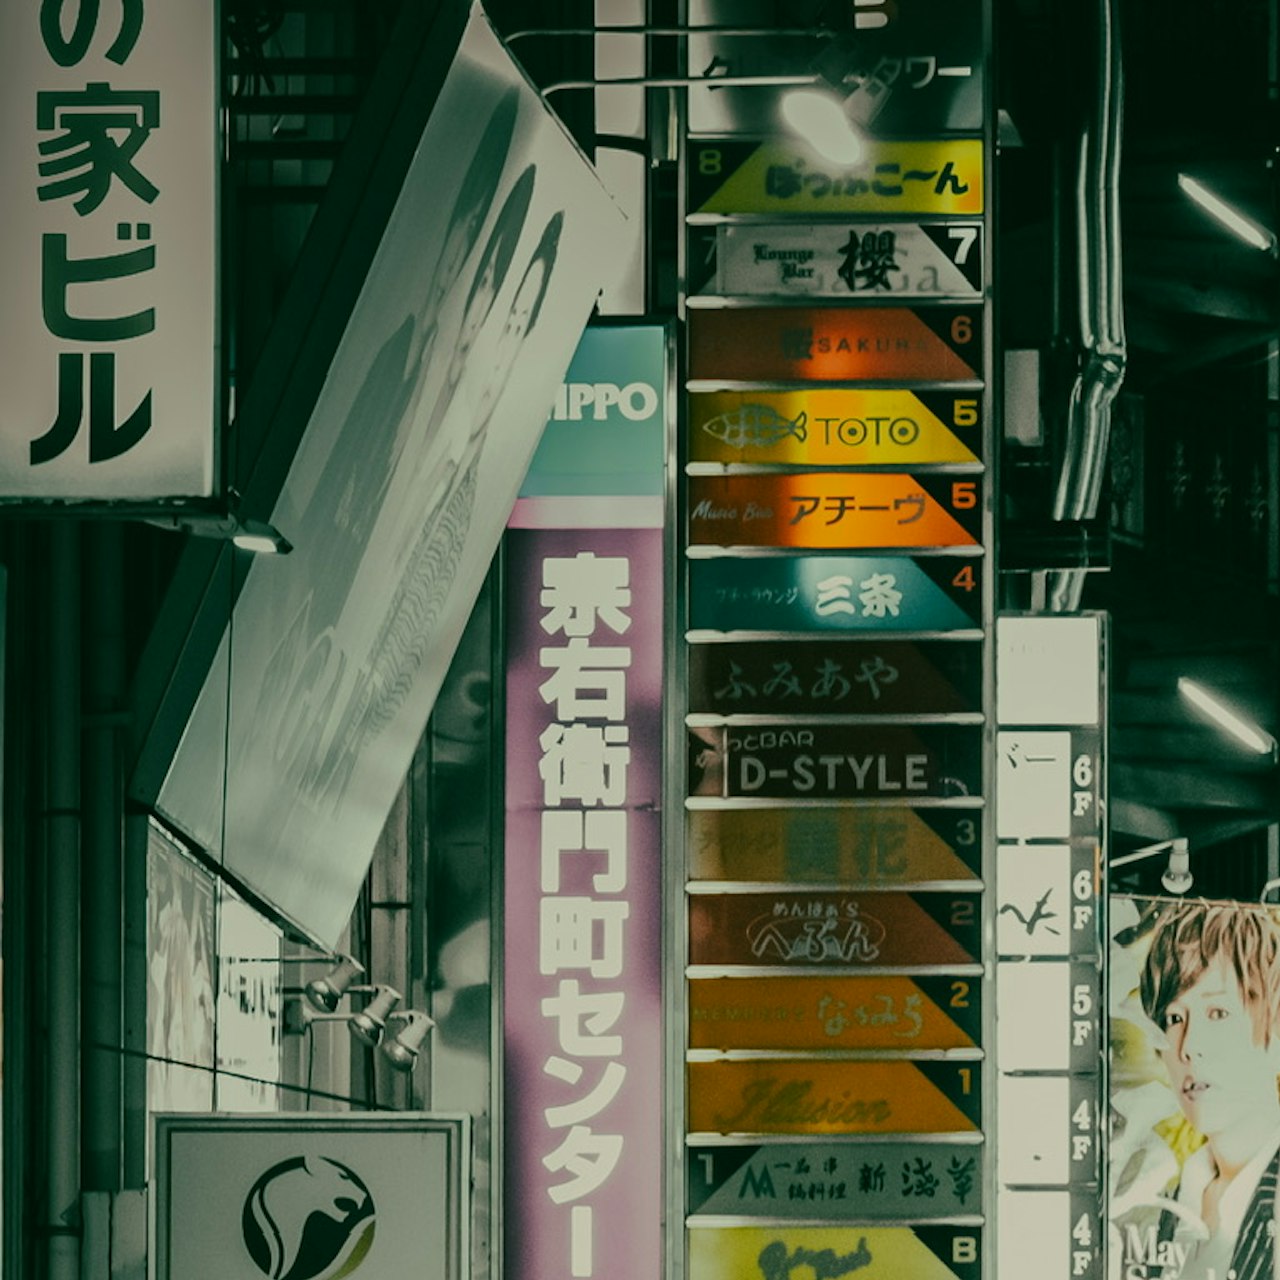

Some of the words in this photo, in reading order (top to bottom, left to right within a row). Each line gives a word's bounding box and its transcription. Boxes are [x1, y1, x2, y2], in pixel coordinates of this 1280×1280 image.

[948, 228, 977, 264] 7
[951, 316, 972, 343] 6
[548, 382, 658, 420] IPPO
[953, 399, 977, 426] 5
[815, 417, 919, 446] TOTO
[952, 483, 976, 509] 5
[952, 566, 975, 592] 4
[715, 656, 899, 700] ふみあや
[740, 754, 928, 791] D-STYLE
[1073, 755, 1092, 816] 6F
[956, 819, 975, 845] 3
[538, 552, 632, 1277] 宗右衛門町センター
[951, 902, 974, 926] 2
[1073, 870, 1092, 929] 6F
[950, 982, 970, 1008] 2
[1073, 986, 1092, 1046] 5F
[958, 1069, 971, 1094] 1
[1073, 1101, 1092, 1162] 4F
[1073, 1213, 1092, 1276] 4F
[1125, 1224, 1190, 1271] May
